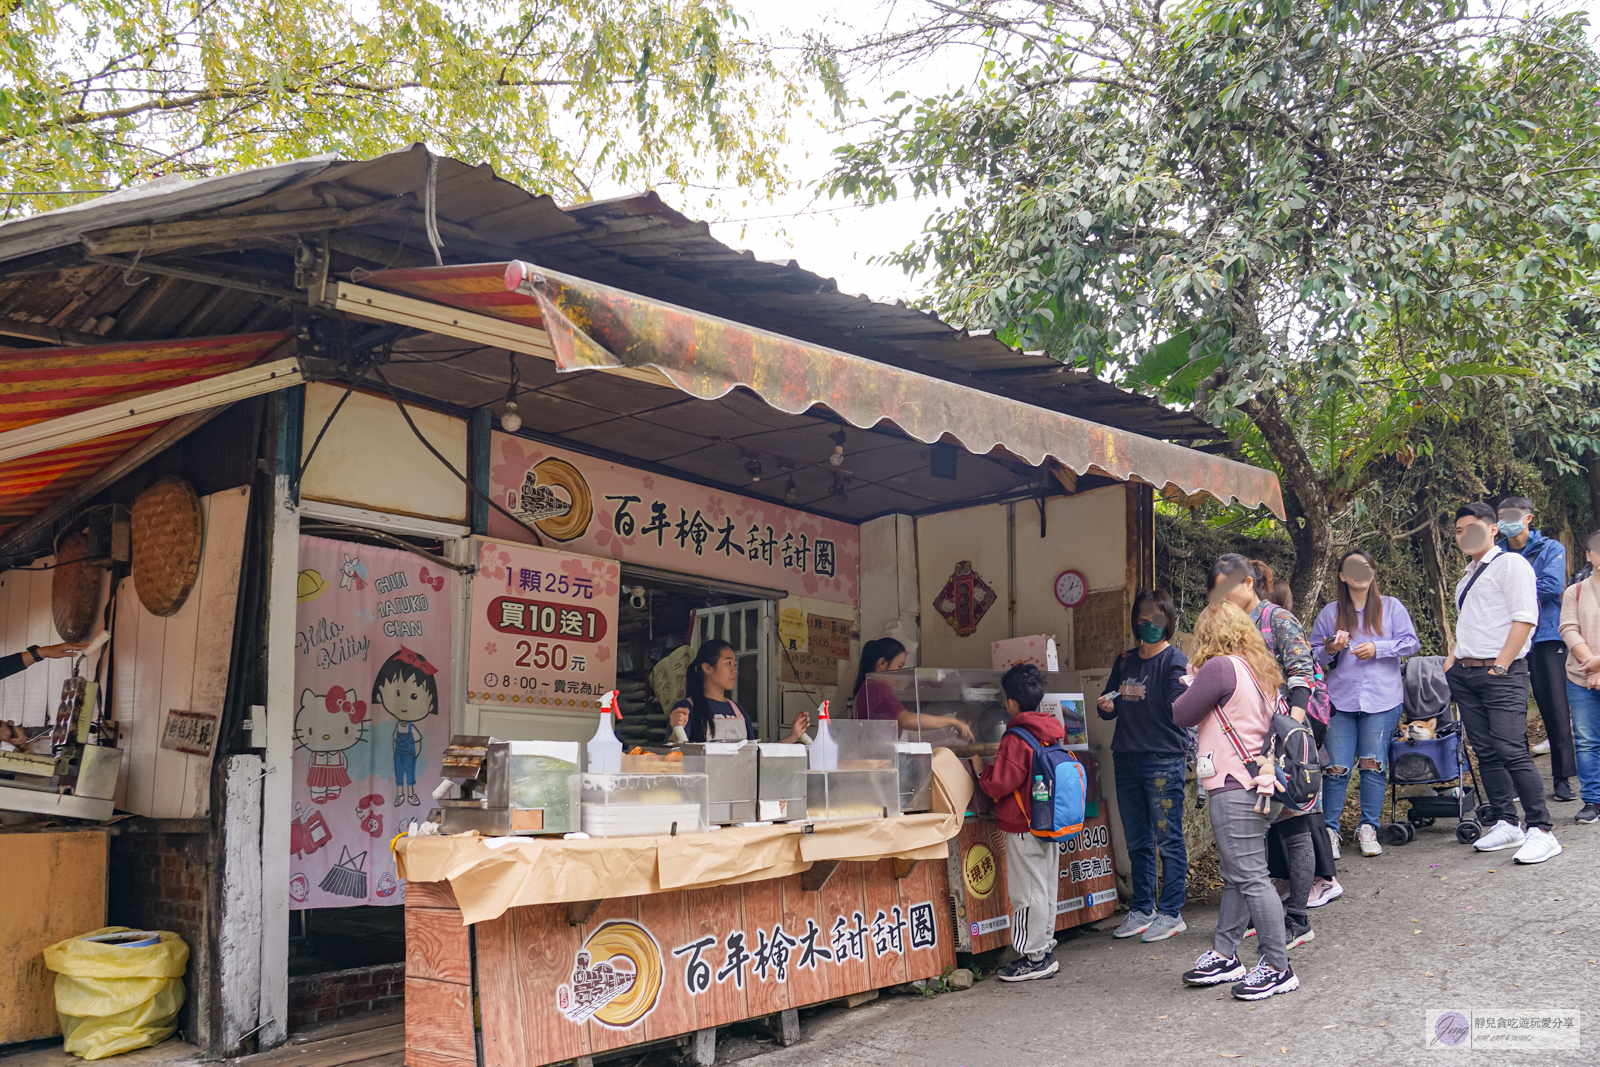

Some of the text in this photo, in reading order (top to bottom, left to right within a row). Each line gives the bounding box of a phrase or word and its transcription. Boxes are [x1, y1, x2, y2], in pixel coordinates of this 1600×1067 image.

[605, 495, 835, 578] 百年檜木甜甜圈
[506, 566, 594, 600] 1顆25元
[295, 617, 344, 655] Hello
[499, 600, 597, 639] 買10送1
[317, 636, 371, 670] Kitty
[515, 640, 586, 672] 250元
[553, 679, 605, 696] 賣完為止
[969, 856, 993, 883] 現烤
[1071, 855, 1112, 882] 賣完為止
[673, 904, 937, 993] 百年檜木甜甜圈
